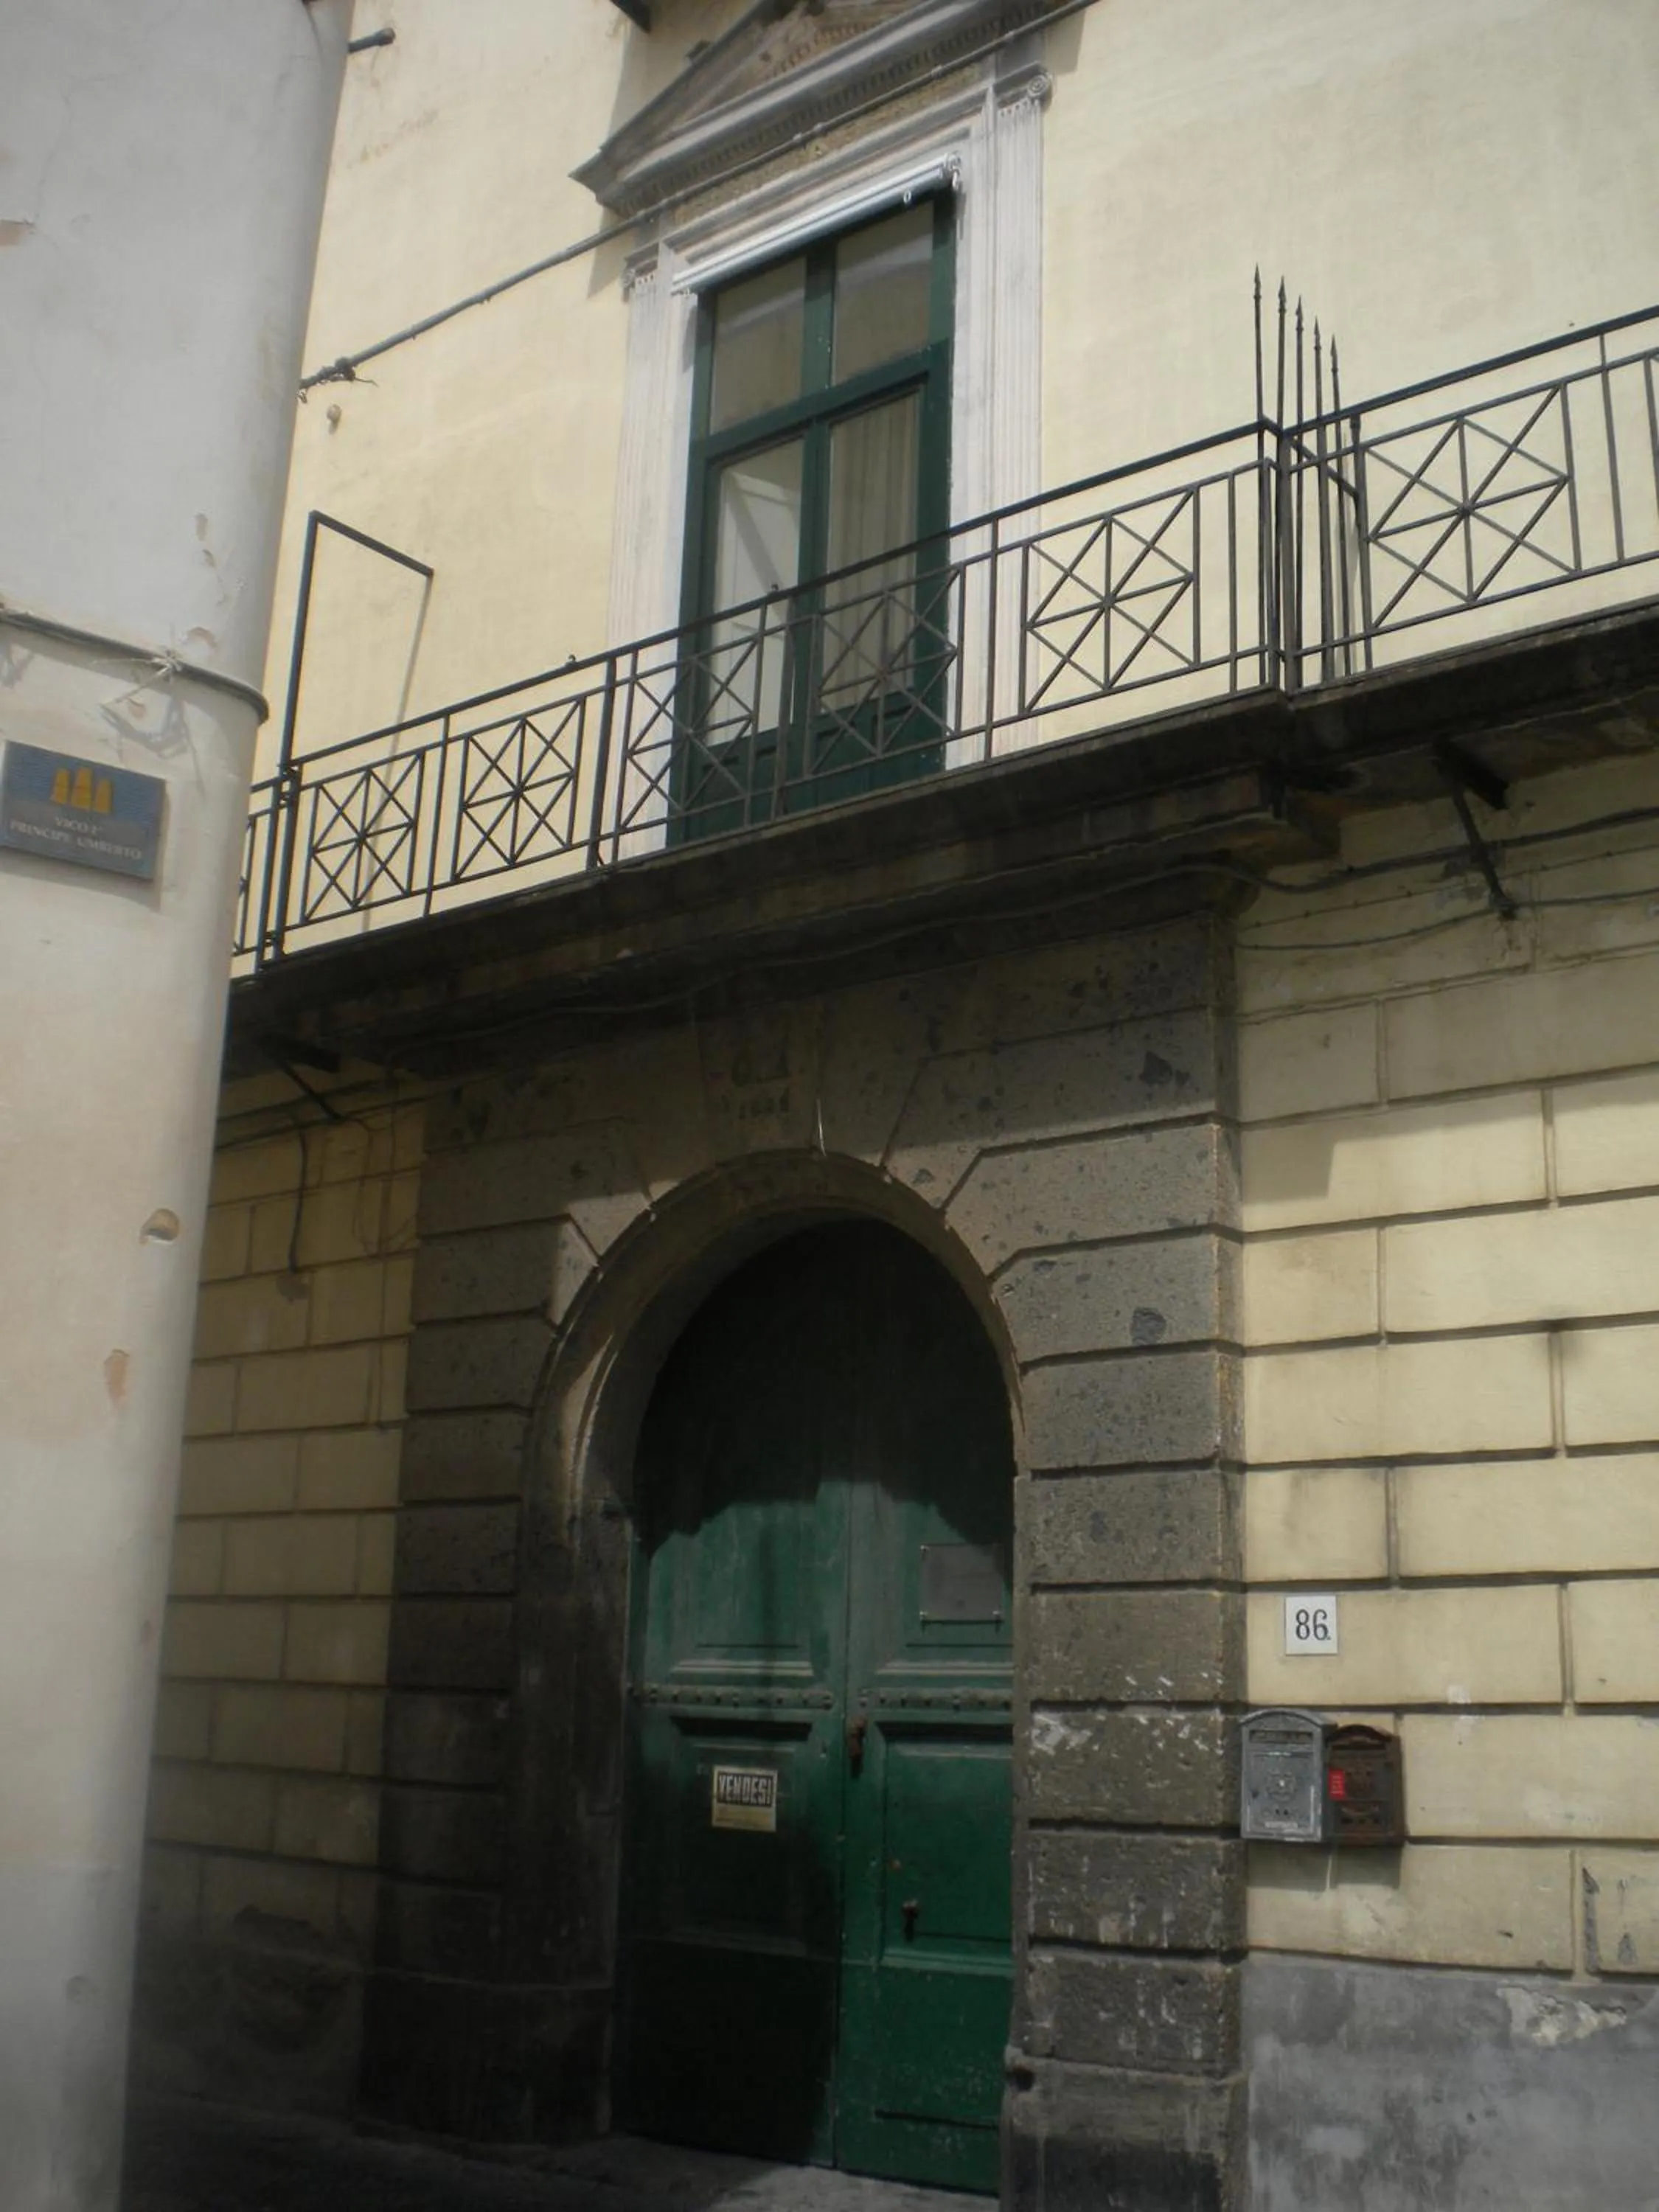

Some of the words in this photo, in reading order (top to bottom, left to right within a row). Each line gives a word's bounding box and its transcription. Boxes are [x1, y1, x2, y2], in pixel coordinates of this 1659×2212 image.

[10, 820, 70, 842] PRINCIPE
[76, 835, 142, 860] UMBERTO
[55, 815, 89, 833] VICO
[1295, 1608, 1329, 1641] 86
